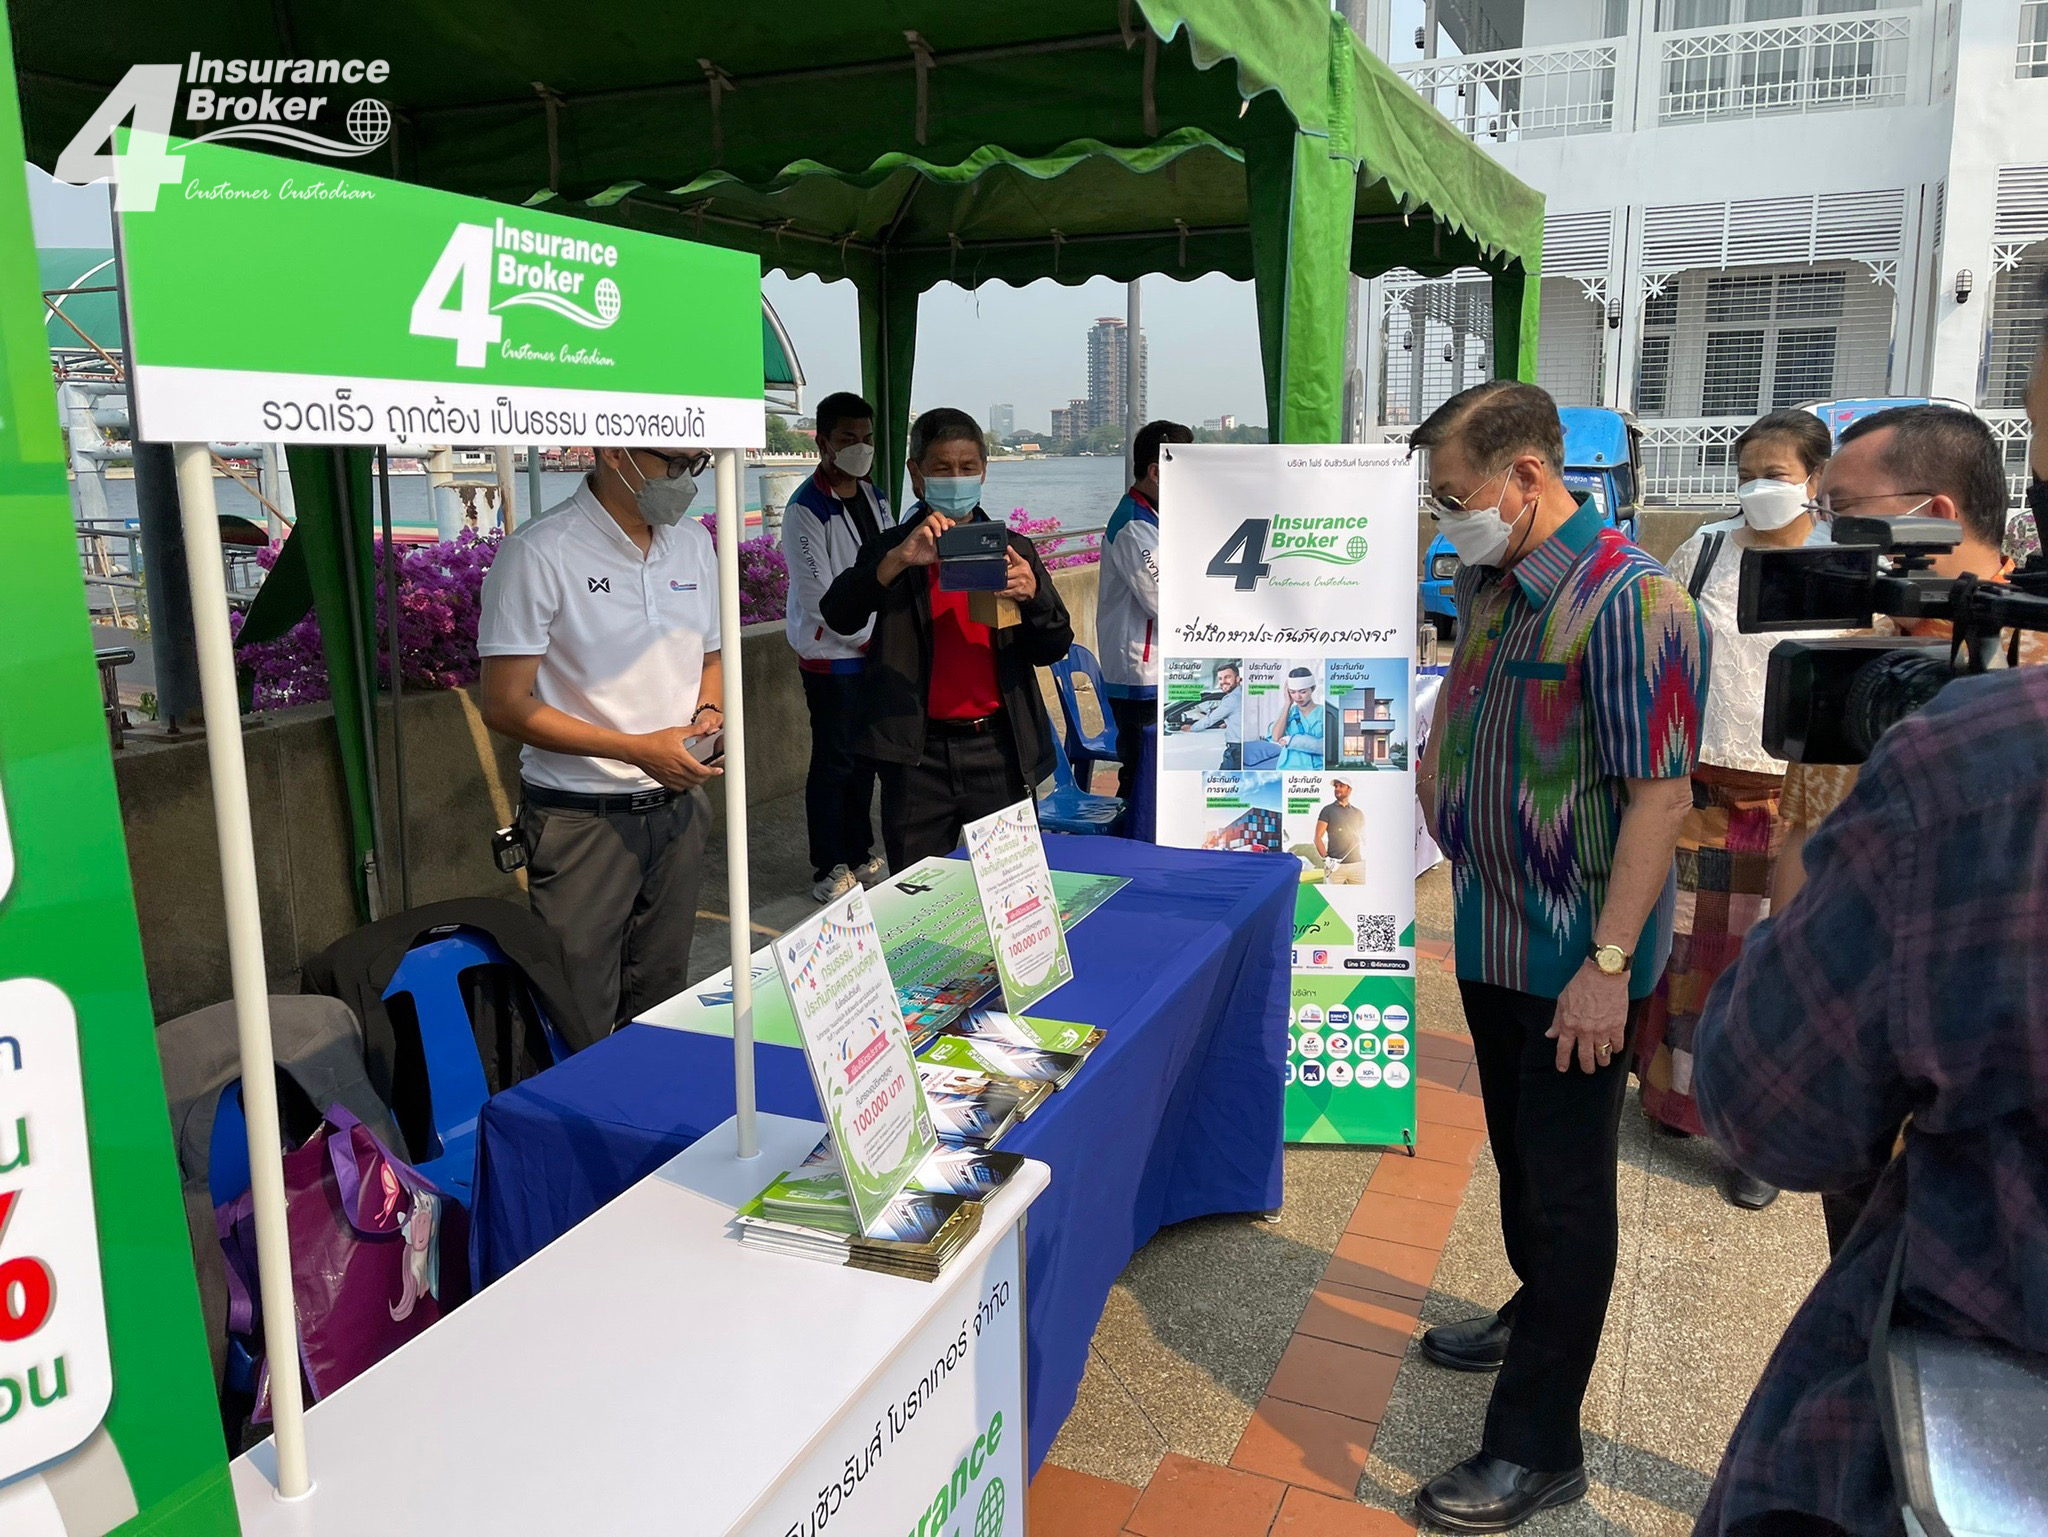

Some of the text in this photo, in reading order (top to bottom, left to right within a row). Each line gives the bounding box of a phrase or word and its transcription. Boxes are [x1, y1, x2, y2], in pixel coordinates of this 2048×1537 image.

[494, 217, 618, 268] Insurance
[497, 259, 585, 296] Broker
[409, 222, 502, 368] 4
[501, 339, 616, 368] Customer Custodian
[262, 388, 706, 445] รวดเร็ว ถูกต้อง เป็นธรรม ตรวจสอบได้
[1272, 514, 1368, 530] Insurance
[1271, 532, 1338, 548] Broker
[800, 535, 820, 579] THAILAND
[1141, 549, 1160, 583] ILAND
[1206, 518, 1272, 592] 4
[1269, 576, 1360, 587] Customer Custodian
[1168, 662, 1202, 671] ประกันภัย
[1248, 662, 1282, 671] ประกันภัย
[1330, 662, 1364, 671] ประกันภัย
[1207, 776, 1240, 784] ประกันภัย
[1288, 776, 1322, 784] ประกันภัย
[894, 881, 934, 896] 4
[1008, 932, 1037, 957] 100,000
[853, 1088, 889, 1138] 100,000
[888, 1073, 906, 1100] บาท
[887, 1319, 968, 1443] โบรกเกอร์
[973, 1280, 1010, 1337] จำกัด
